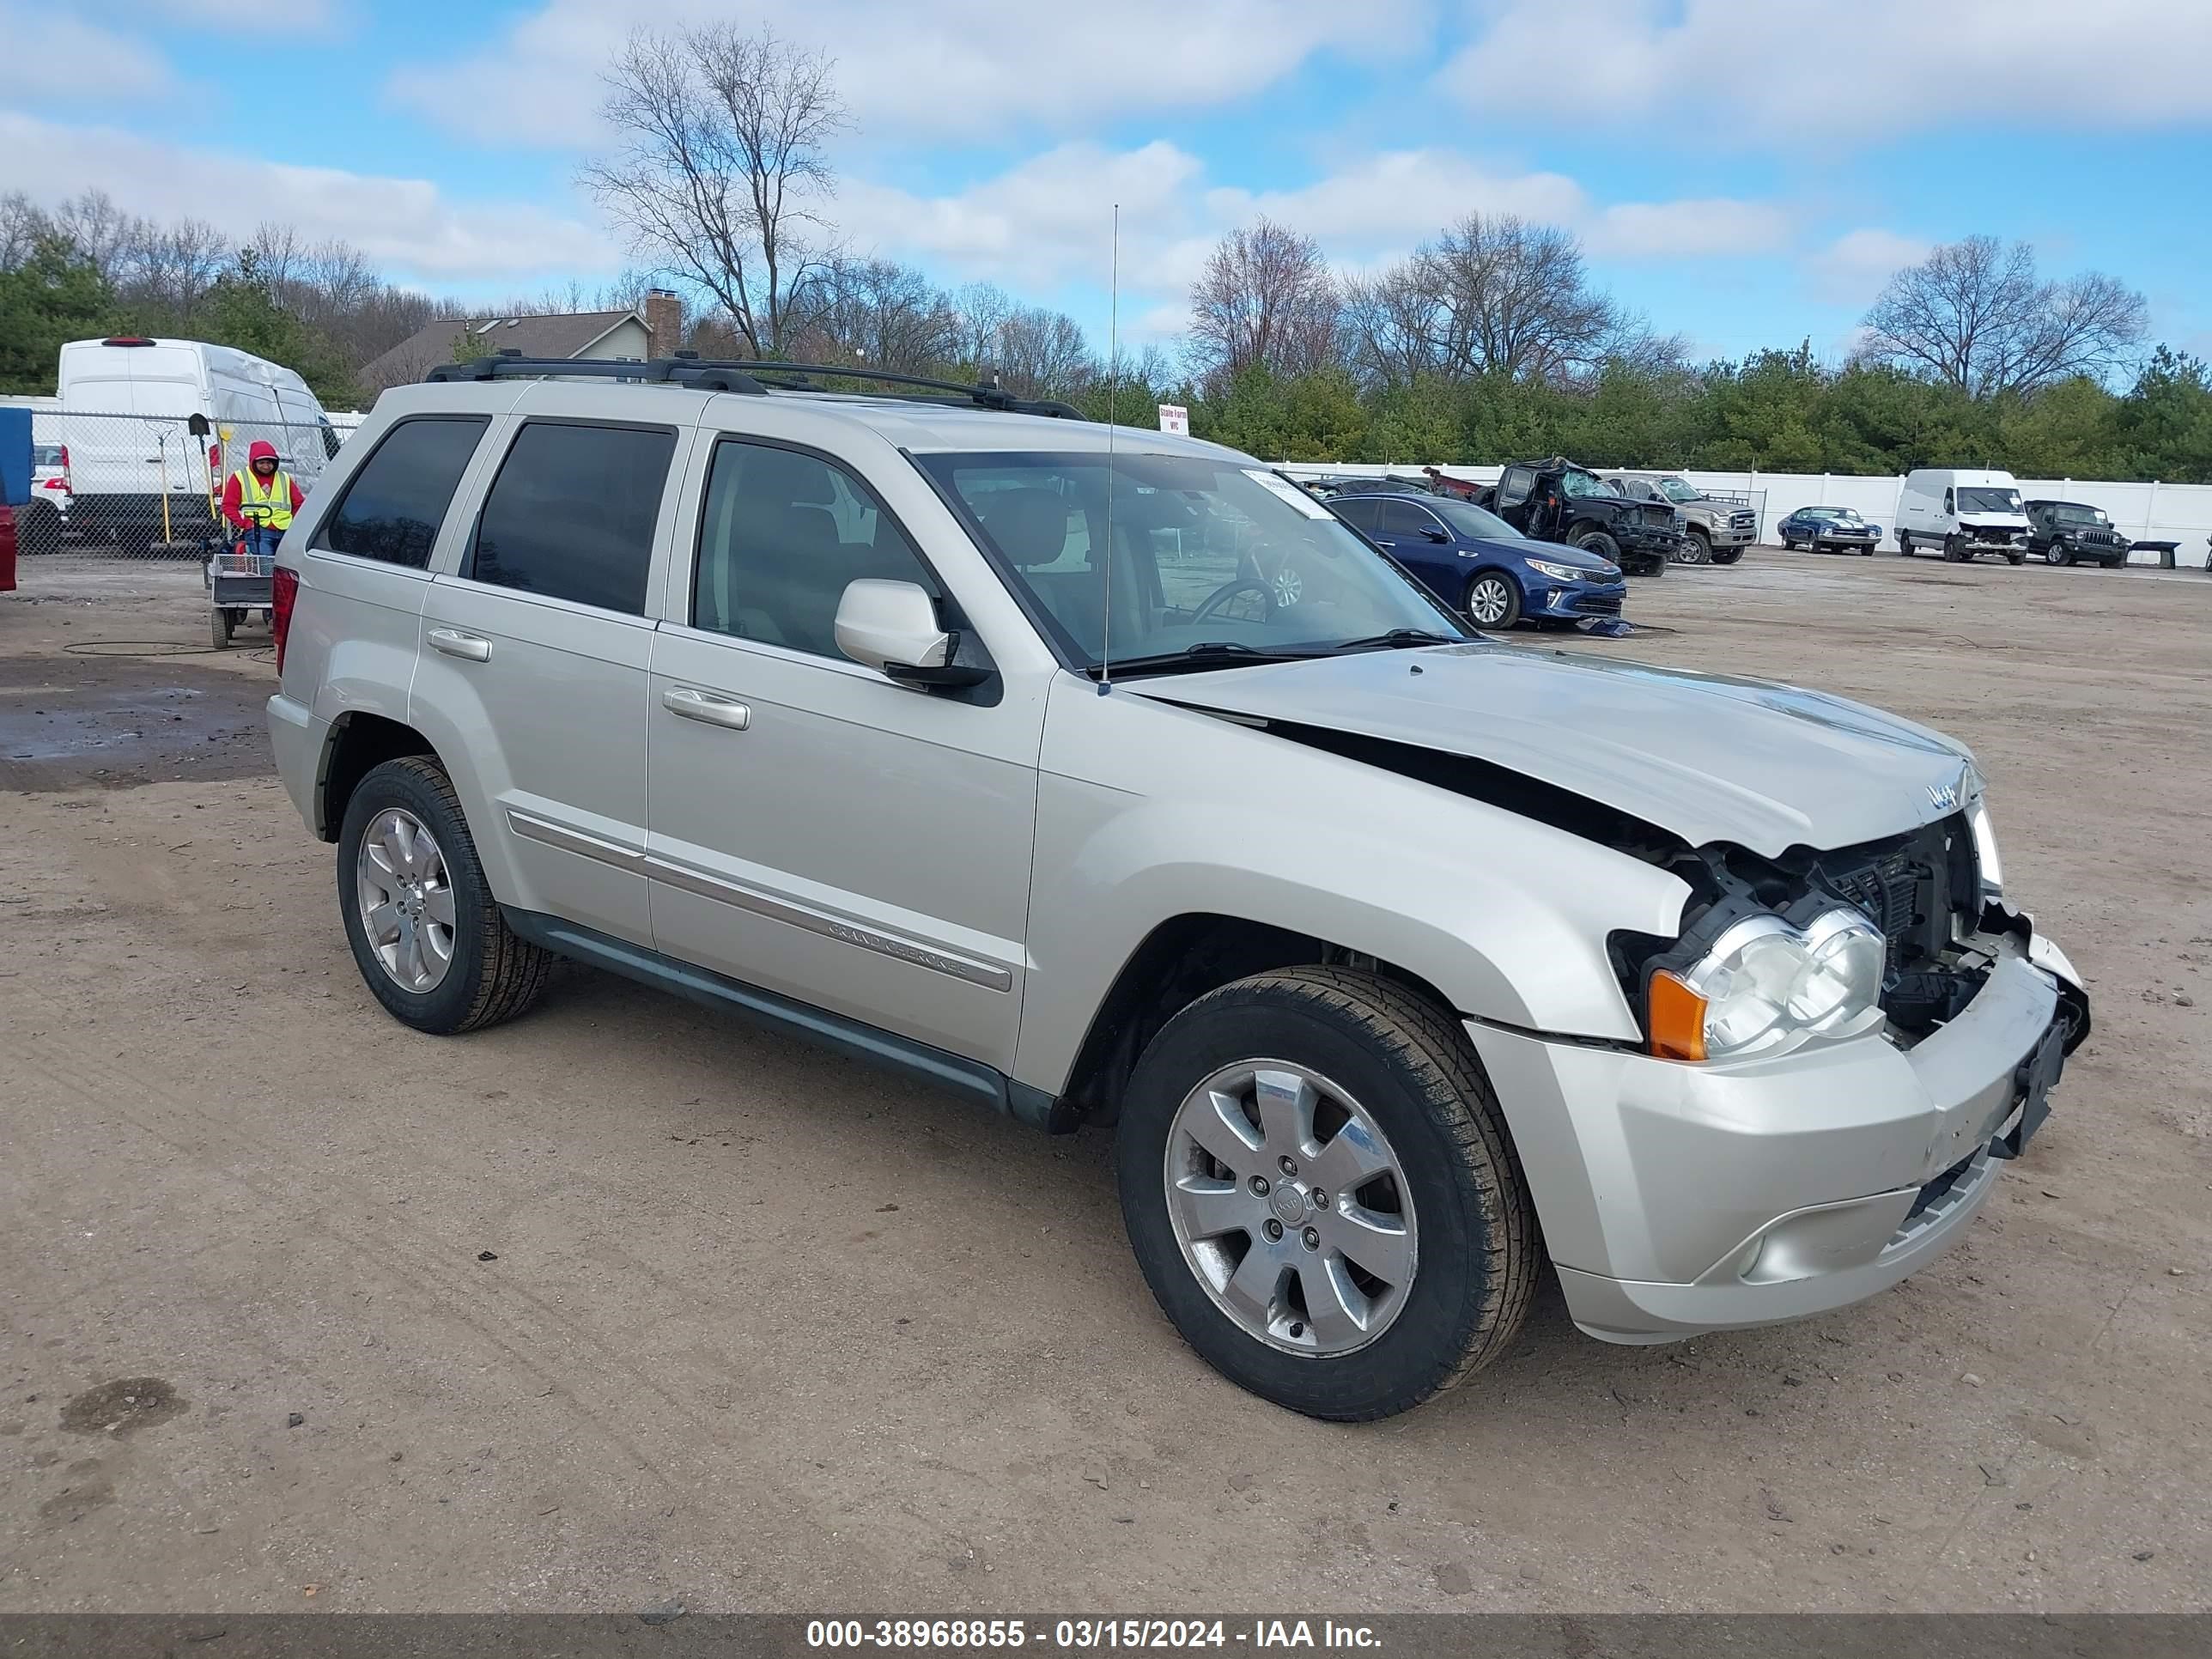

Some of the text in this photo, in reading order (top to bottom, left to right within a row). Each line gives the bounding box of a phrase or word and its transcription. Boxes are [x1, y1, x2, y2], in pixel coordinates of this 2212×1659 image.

[1174, 410, 1188, 419] Farm
[829, 923, 969, 975] GRAND CHEROKEE
